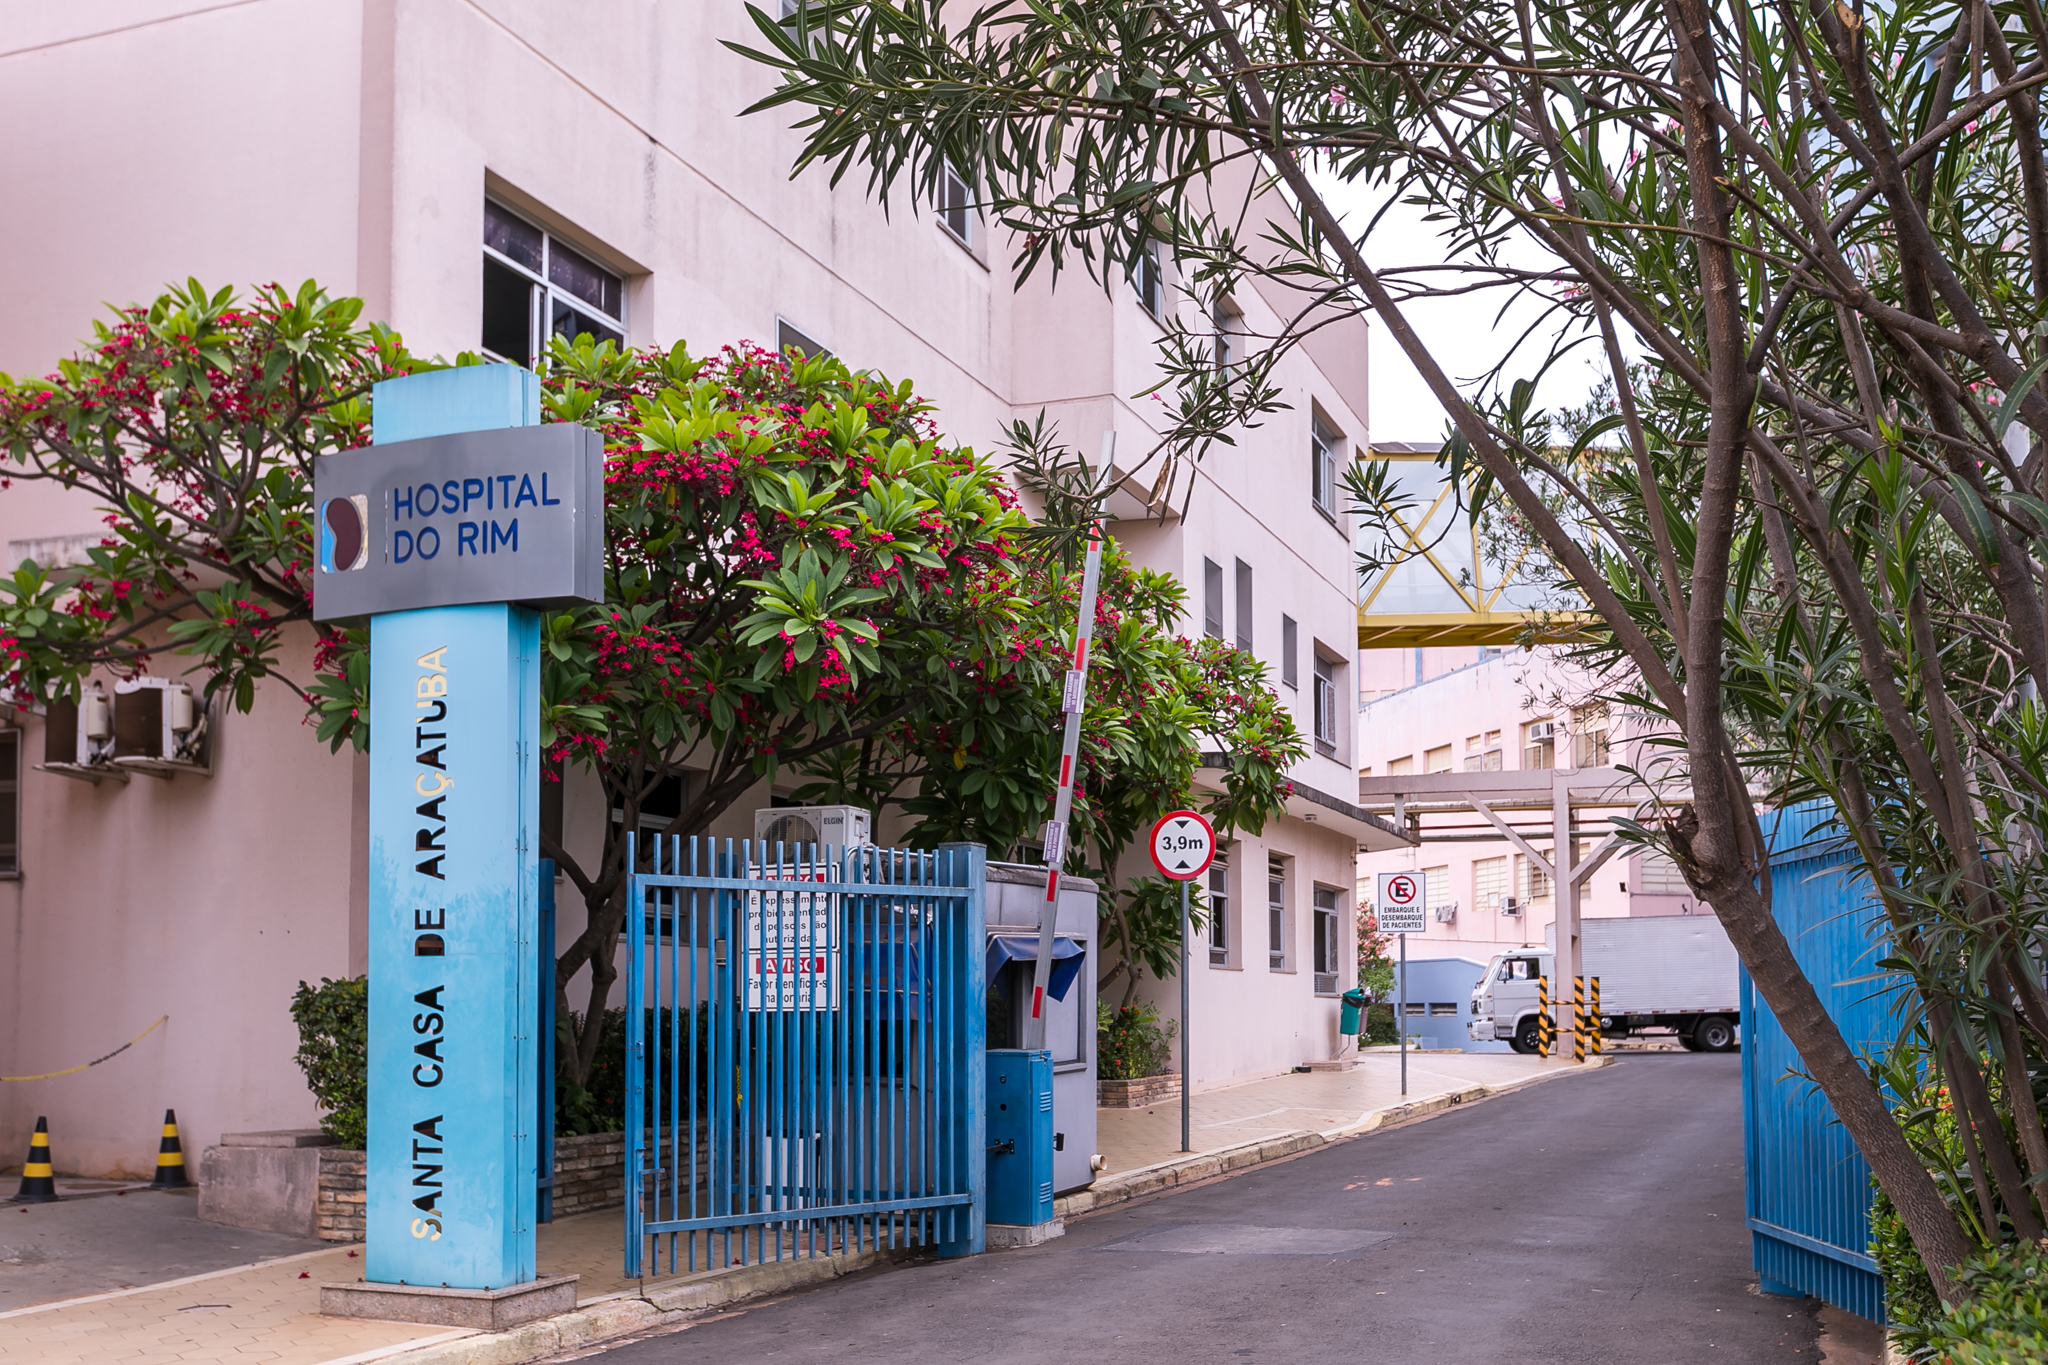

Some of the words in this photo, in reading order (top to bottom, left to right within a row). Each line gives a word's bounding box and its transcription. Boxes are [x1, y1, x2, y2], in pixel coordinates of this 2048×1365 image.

[394, 472, 560, 521] HOSPITAL
[394, 526, 440, 564] DO
[458, 518, 518, 557] RIM
[415, 645, 455, 881] ARAÇATUBA
[823, 817, 843, 825] ELGIN
[1162, 835, 1203, 854] 3,9m
[1395, 883, 1408, 897] E
[751, 895, 757, 905] É
[1384, 906, 1415, 914] EMBARQUE
[415, 908, 446, 956] DE
[813, 921, 828, 929] ão
[1382, 921, 1390, 929] DE
[1391, 921, 1422, 929] PACIENTES
[412, 984, 445, 1088] CASA
[411, 1114, 444, 1242] SANTA
